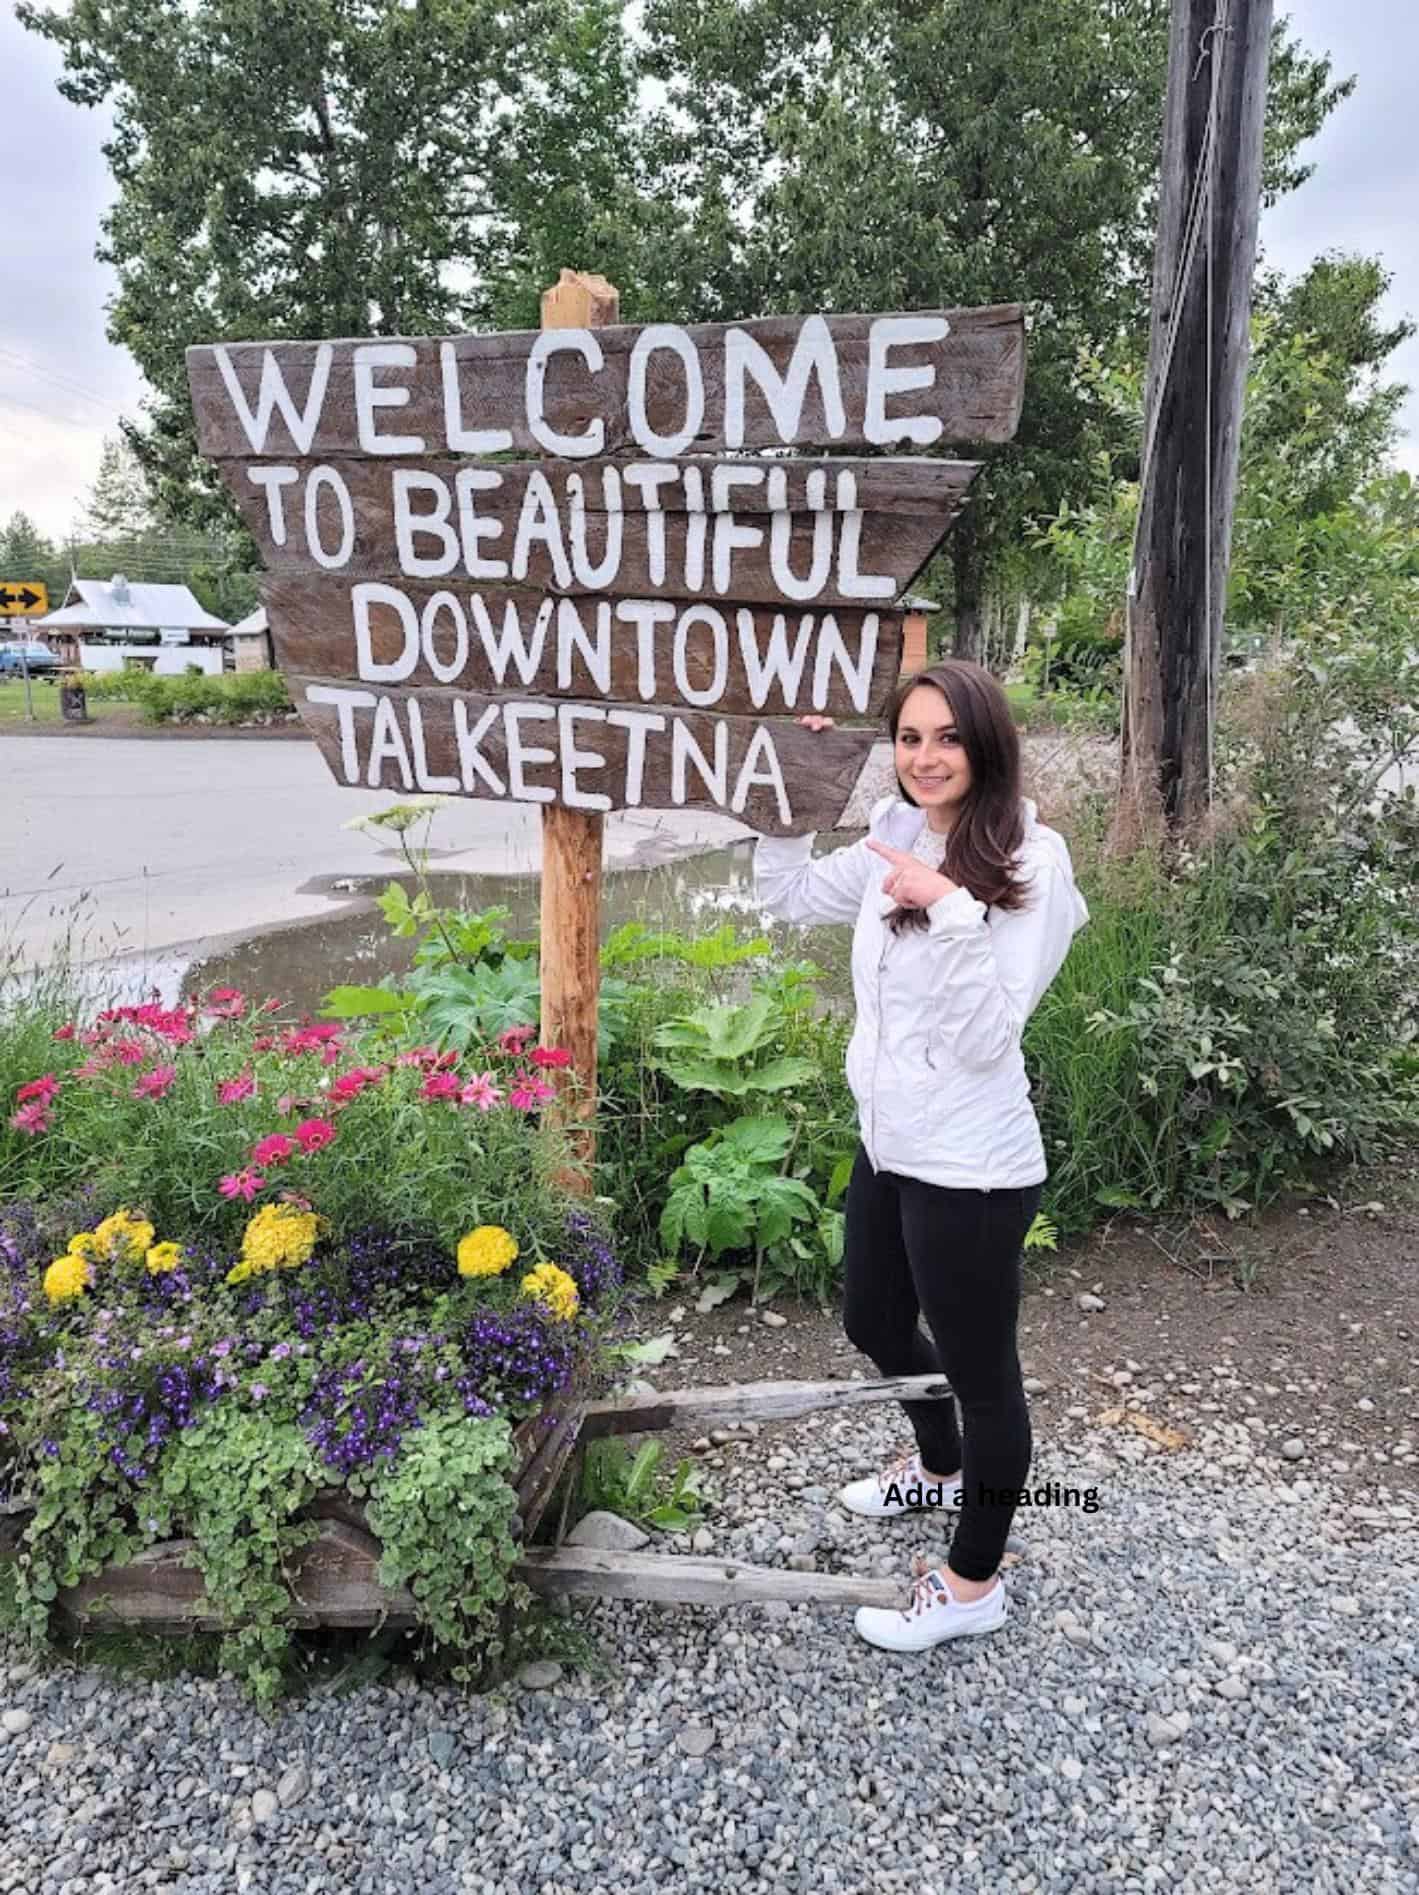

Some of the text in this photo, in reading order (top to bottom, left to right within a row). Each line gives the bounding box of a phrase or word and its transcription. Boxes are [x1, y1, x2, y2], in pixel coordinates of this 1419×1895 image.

[212, 313, 951, 458] WELCOME
[246, 462, 897, 601] TO BEAUTIFUL
[351, 582, 880, 713] DOWNTOWN
[305, 684, 793, 826] TALKEETNA
